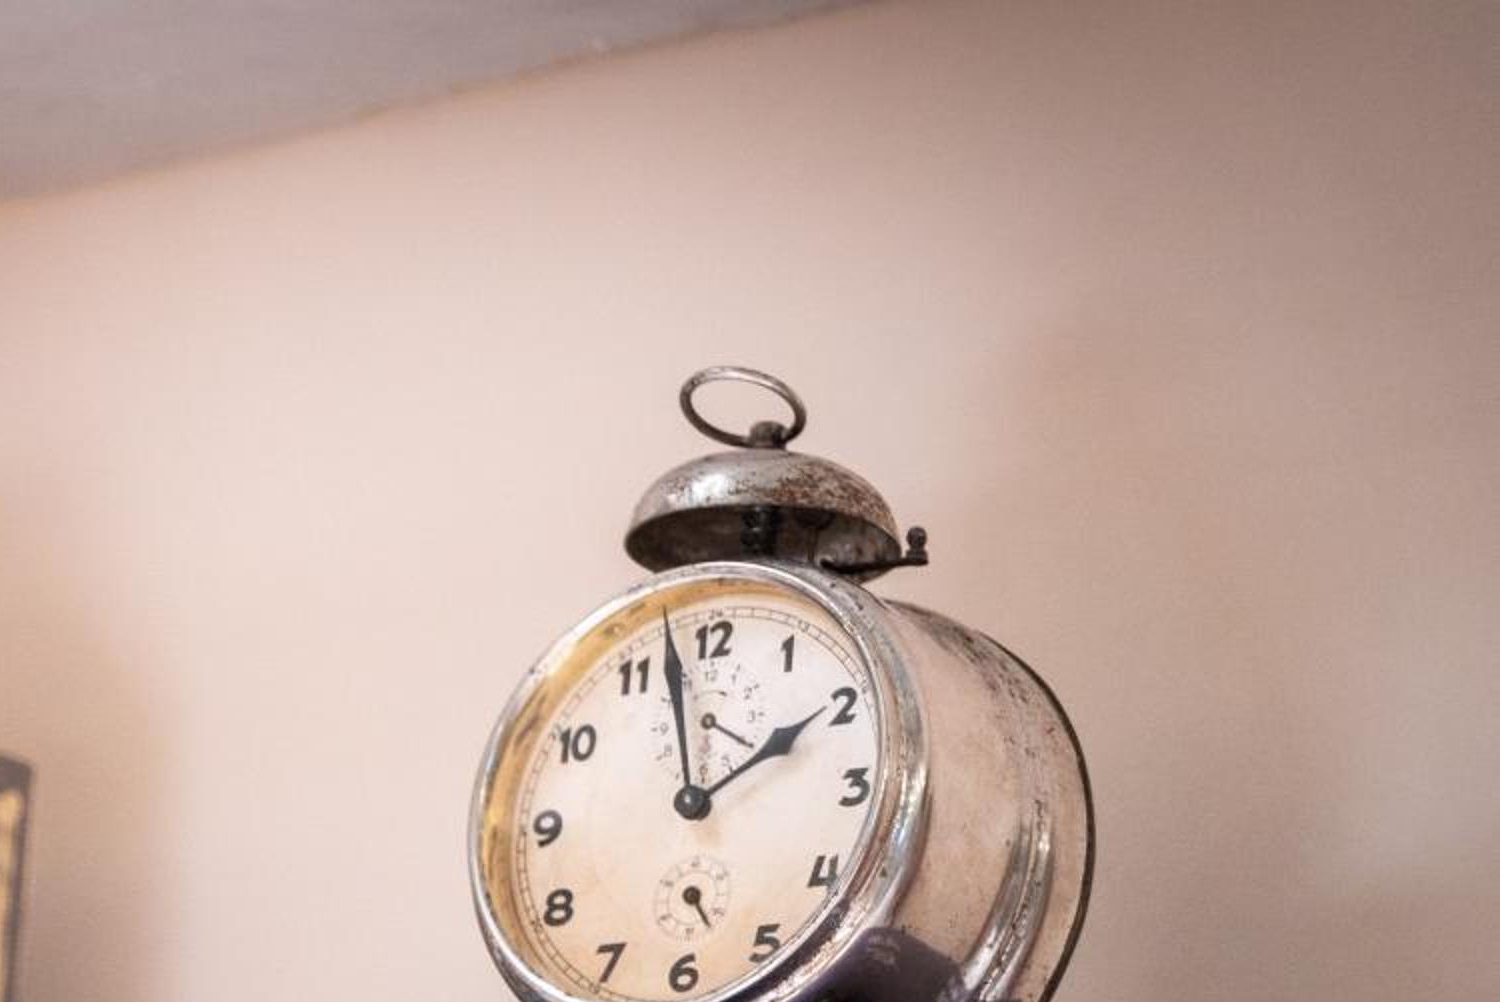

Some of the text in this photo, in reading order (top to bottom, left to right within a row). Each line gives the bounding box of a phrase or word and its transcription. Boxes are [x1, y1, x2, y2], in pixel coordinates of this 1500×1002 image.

[695, 620, 734, 660] 12
[780, 634, 795, 673] 1
[618, 656, 650, 696] 11
[828, 686, 858, 726] 2
[560, 723, 597, 763] 10
[838, 767, 871, 807] 3
[533, 810, 563, 848] 9
[806, 854, 839, 893] 4
[543, 888, 575, 927] 8
[596, 941, 627, 983] 7
[748, 923, 781, 963] 5
[668, 953, 699, 993] 6
